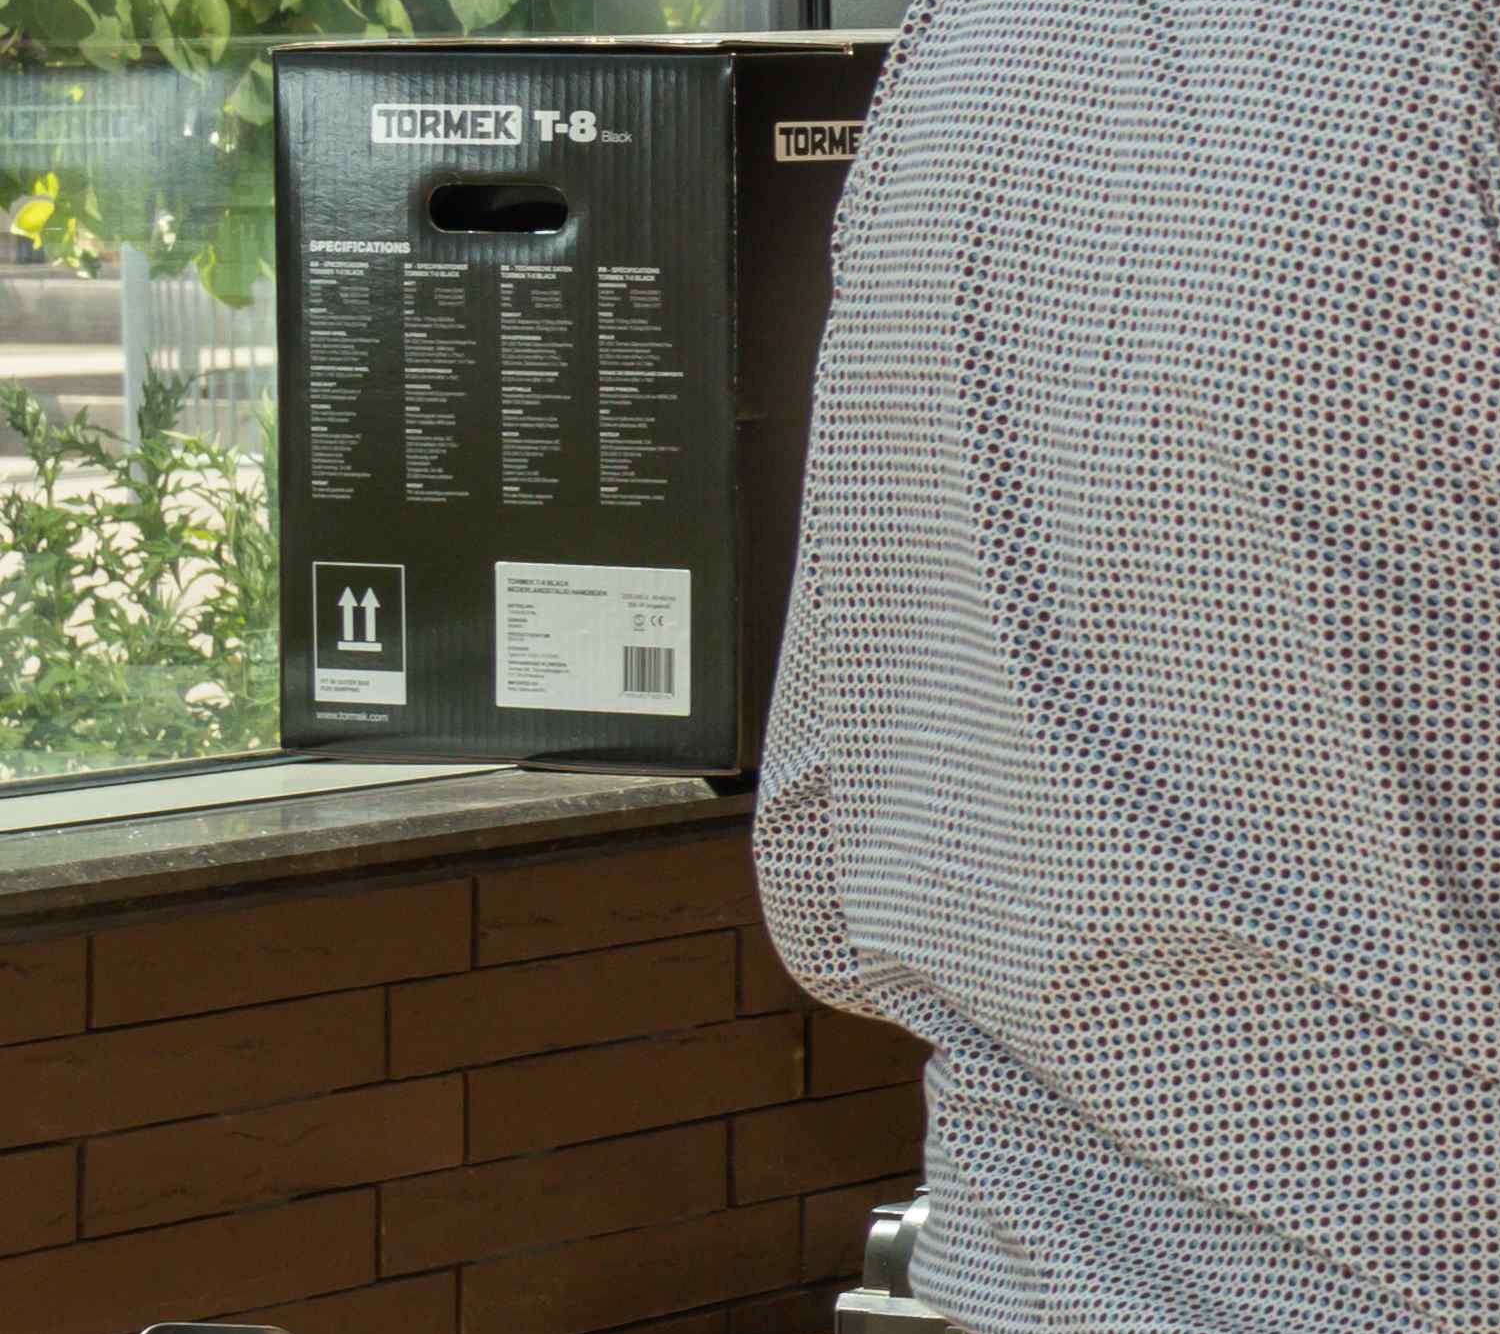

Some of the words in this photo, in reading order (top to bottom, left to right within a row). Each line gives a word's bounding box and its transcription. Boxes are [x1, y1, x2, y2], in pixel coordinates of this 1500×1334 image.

[377, 109, 517, 140] TORMEK
[534, 109, 598, 143] T-8
[602, 131, 633, 145] Black
[778, 125, 866, 156] TORME
[309, 240, 412, 255] SPECIFICATIONS
